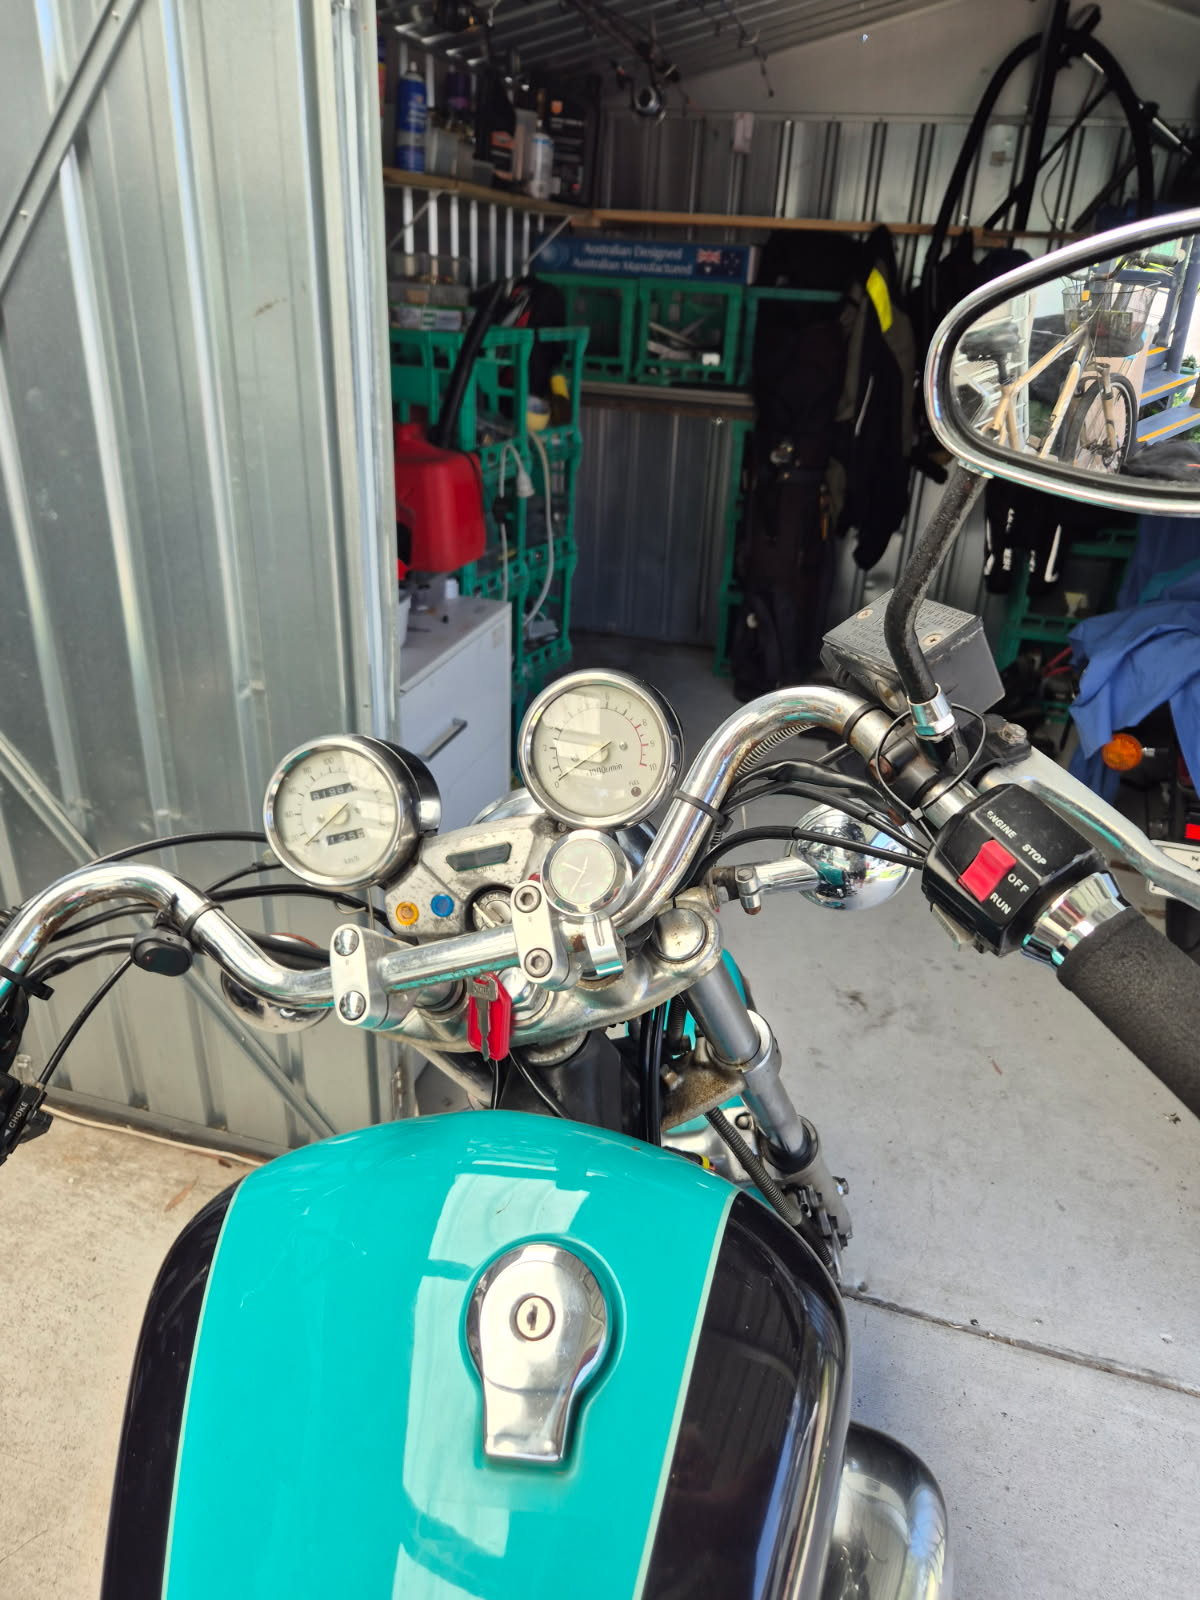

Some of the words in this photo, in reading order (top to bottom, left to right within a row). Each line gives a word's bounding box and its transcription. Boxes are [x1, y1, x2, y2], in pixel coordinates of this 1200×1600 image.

[584, 243, 632, 257] Australian
[634, 246, 684, 261] Designed
[573, 258, 620, 271] Australian
[623, 260, 694, 275] Manufactured
[986, 810, 1017, 839] ENGINE
[1021, 843, 1047, 865] STOP
[1007, 873, 1030, 893] OFF
[989, 892, 1012, 914] RUN
[8, 1101, 29, 1129] CHOKE
